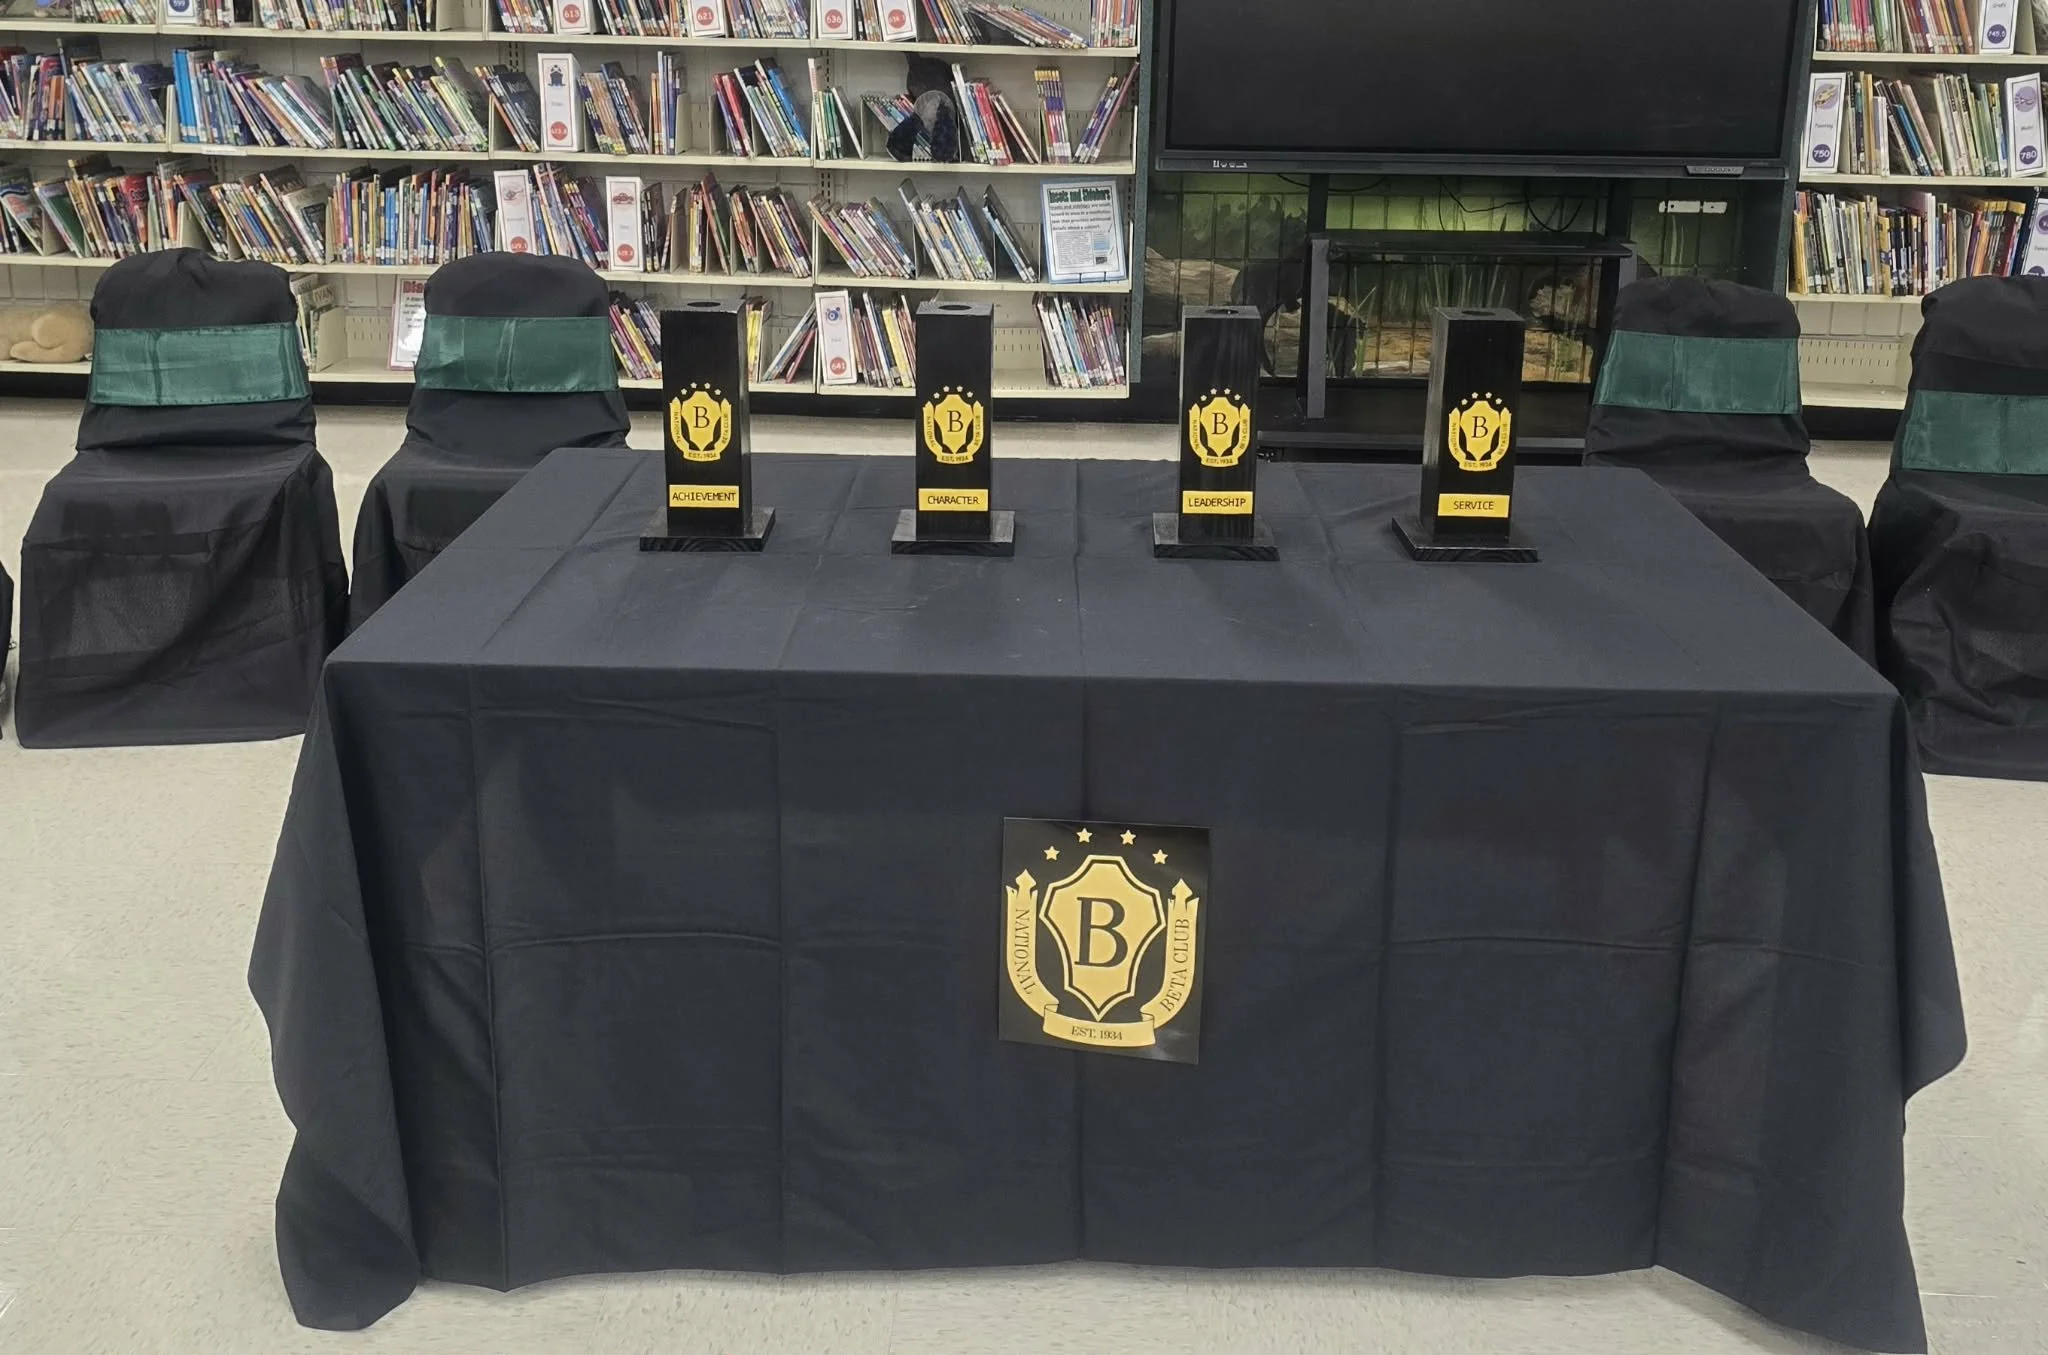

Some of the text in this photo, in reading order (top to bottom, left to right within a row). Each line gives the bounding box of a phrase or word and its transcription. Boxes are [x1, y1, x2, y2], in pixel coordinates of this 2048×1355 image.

[697, 11, 713, 21] 621
[826, 14, 842, 24] 636
[1813, 150, 1830, 158] 750
[2020, 150, 2037, 160] 780
[693, 405, 711, 429] B
[947, 410, 964, 432] B
[1211, 412, 1229, 435] B
[1471, 415, 1489, 438] B
[672, 492, 737, 501] ACHIEVEMENT
[927, 495, 980, 505] CHARACTER
[1188, 497, 1247, 507] LEADERSHIP
[1453, 500, 1495, 510] SERVICE
[1074, 896, 1128, 968] B
[1014, 908, 1036, 995] NATIONAL
[1160, 918, 1190, 1012] BETA CLUB
[1071, 1025, 1123, 1041] EST. 1934
